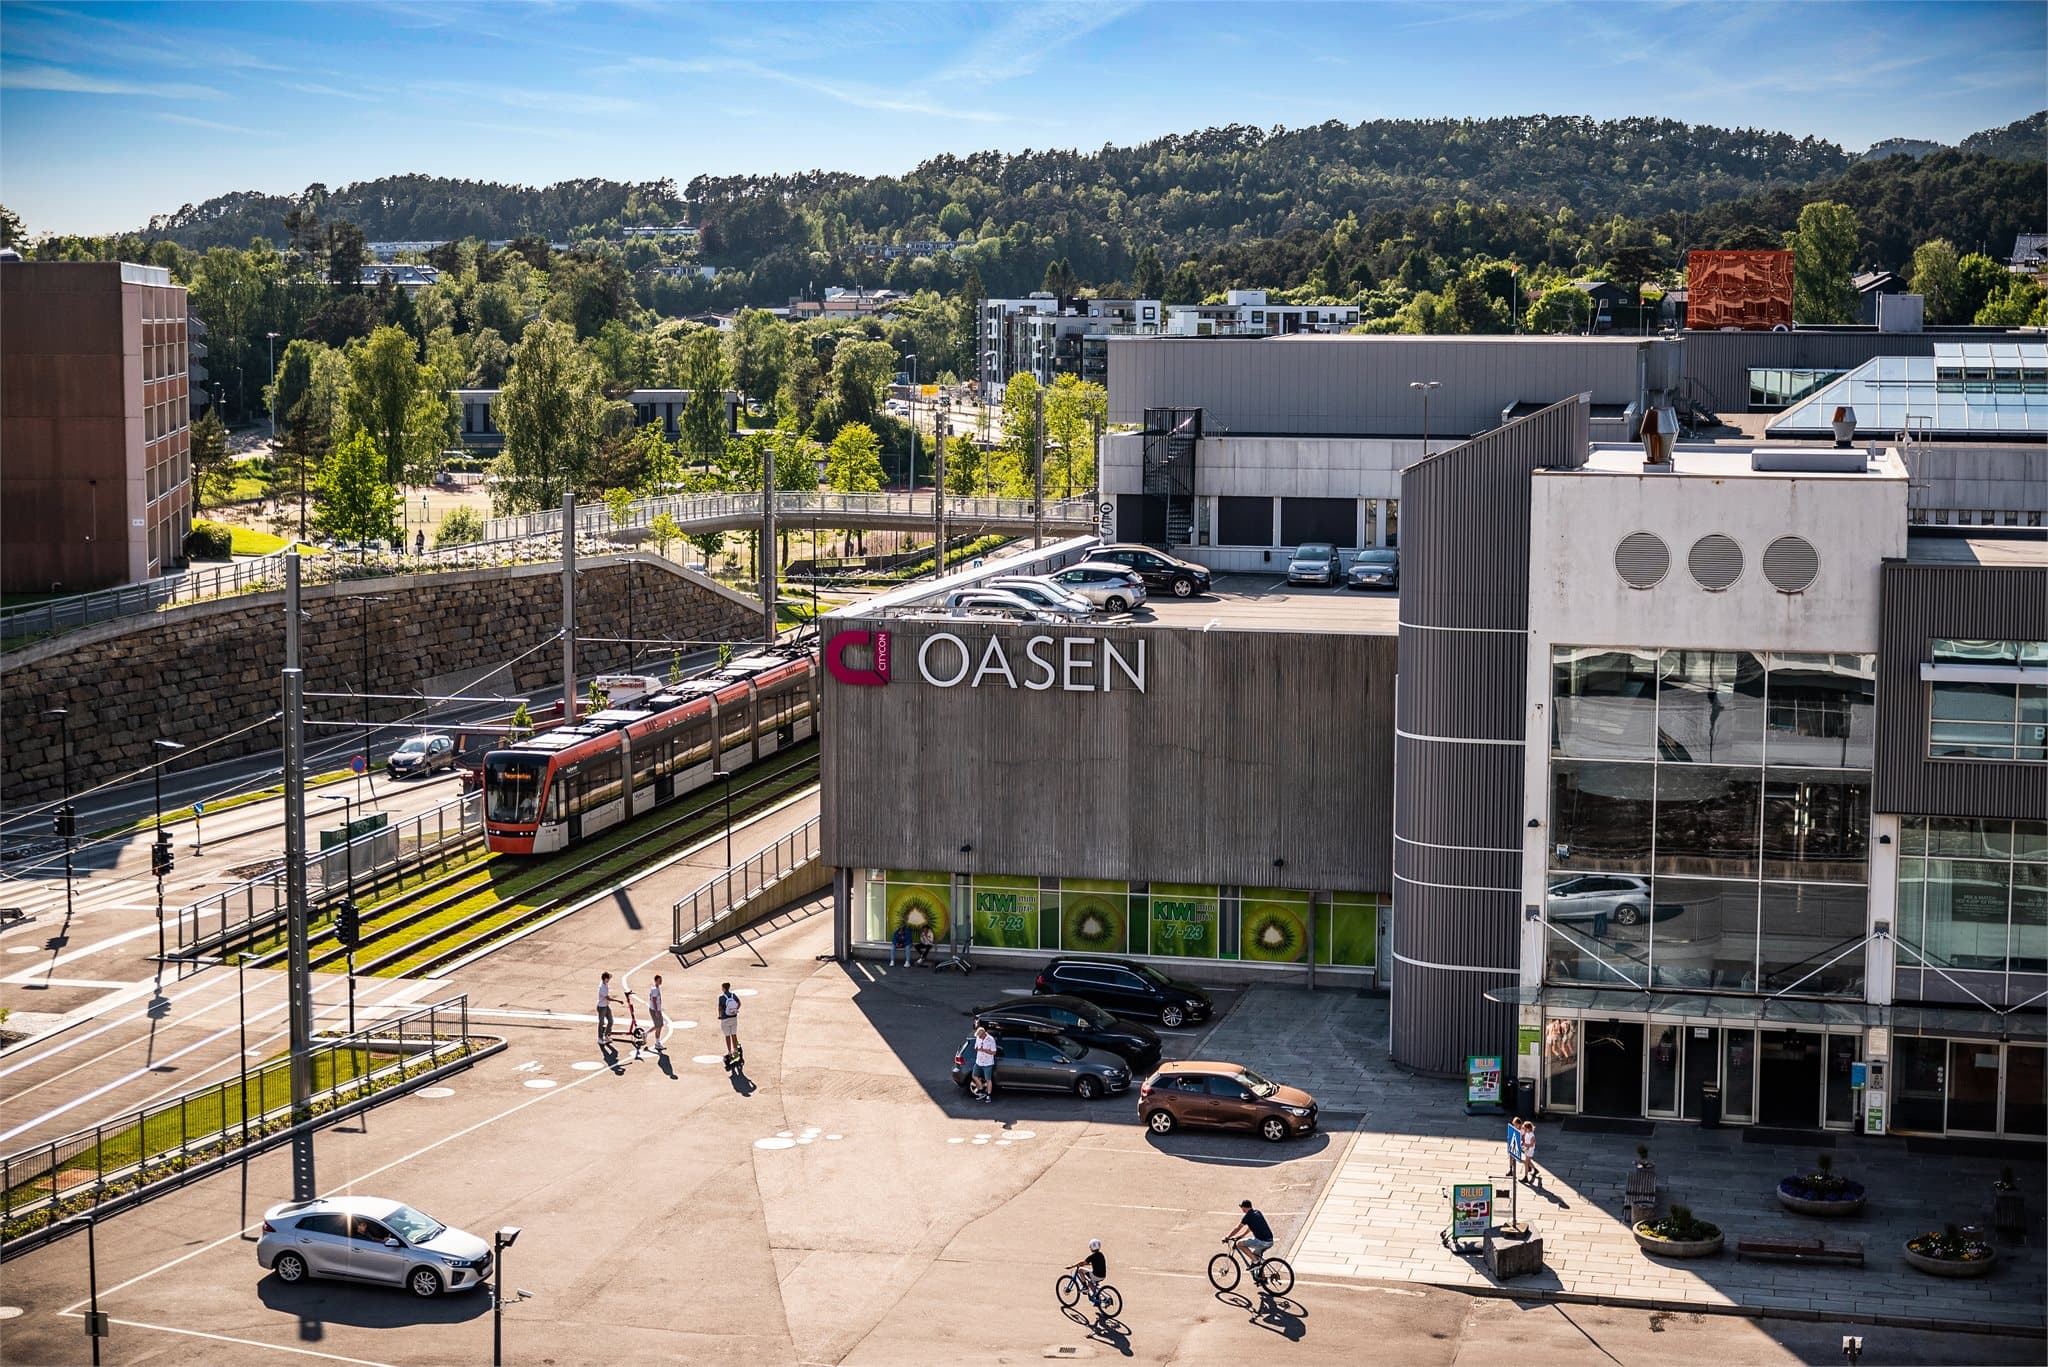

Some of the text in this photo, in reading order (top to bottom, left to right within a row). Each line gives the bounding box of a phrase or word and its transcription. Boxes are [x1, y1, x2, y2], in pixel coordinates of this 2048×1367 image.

[878, 634, 886, 671] CITYCON
[918, 632, 1145, 694] OASEN
[976, 892, 1017, 913] KIWI
[1153, 901, 1196, 922] KIWI
